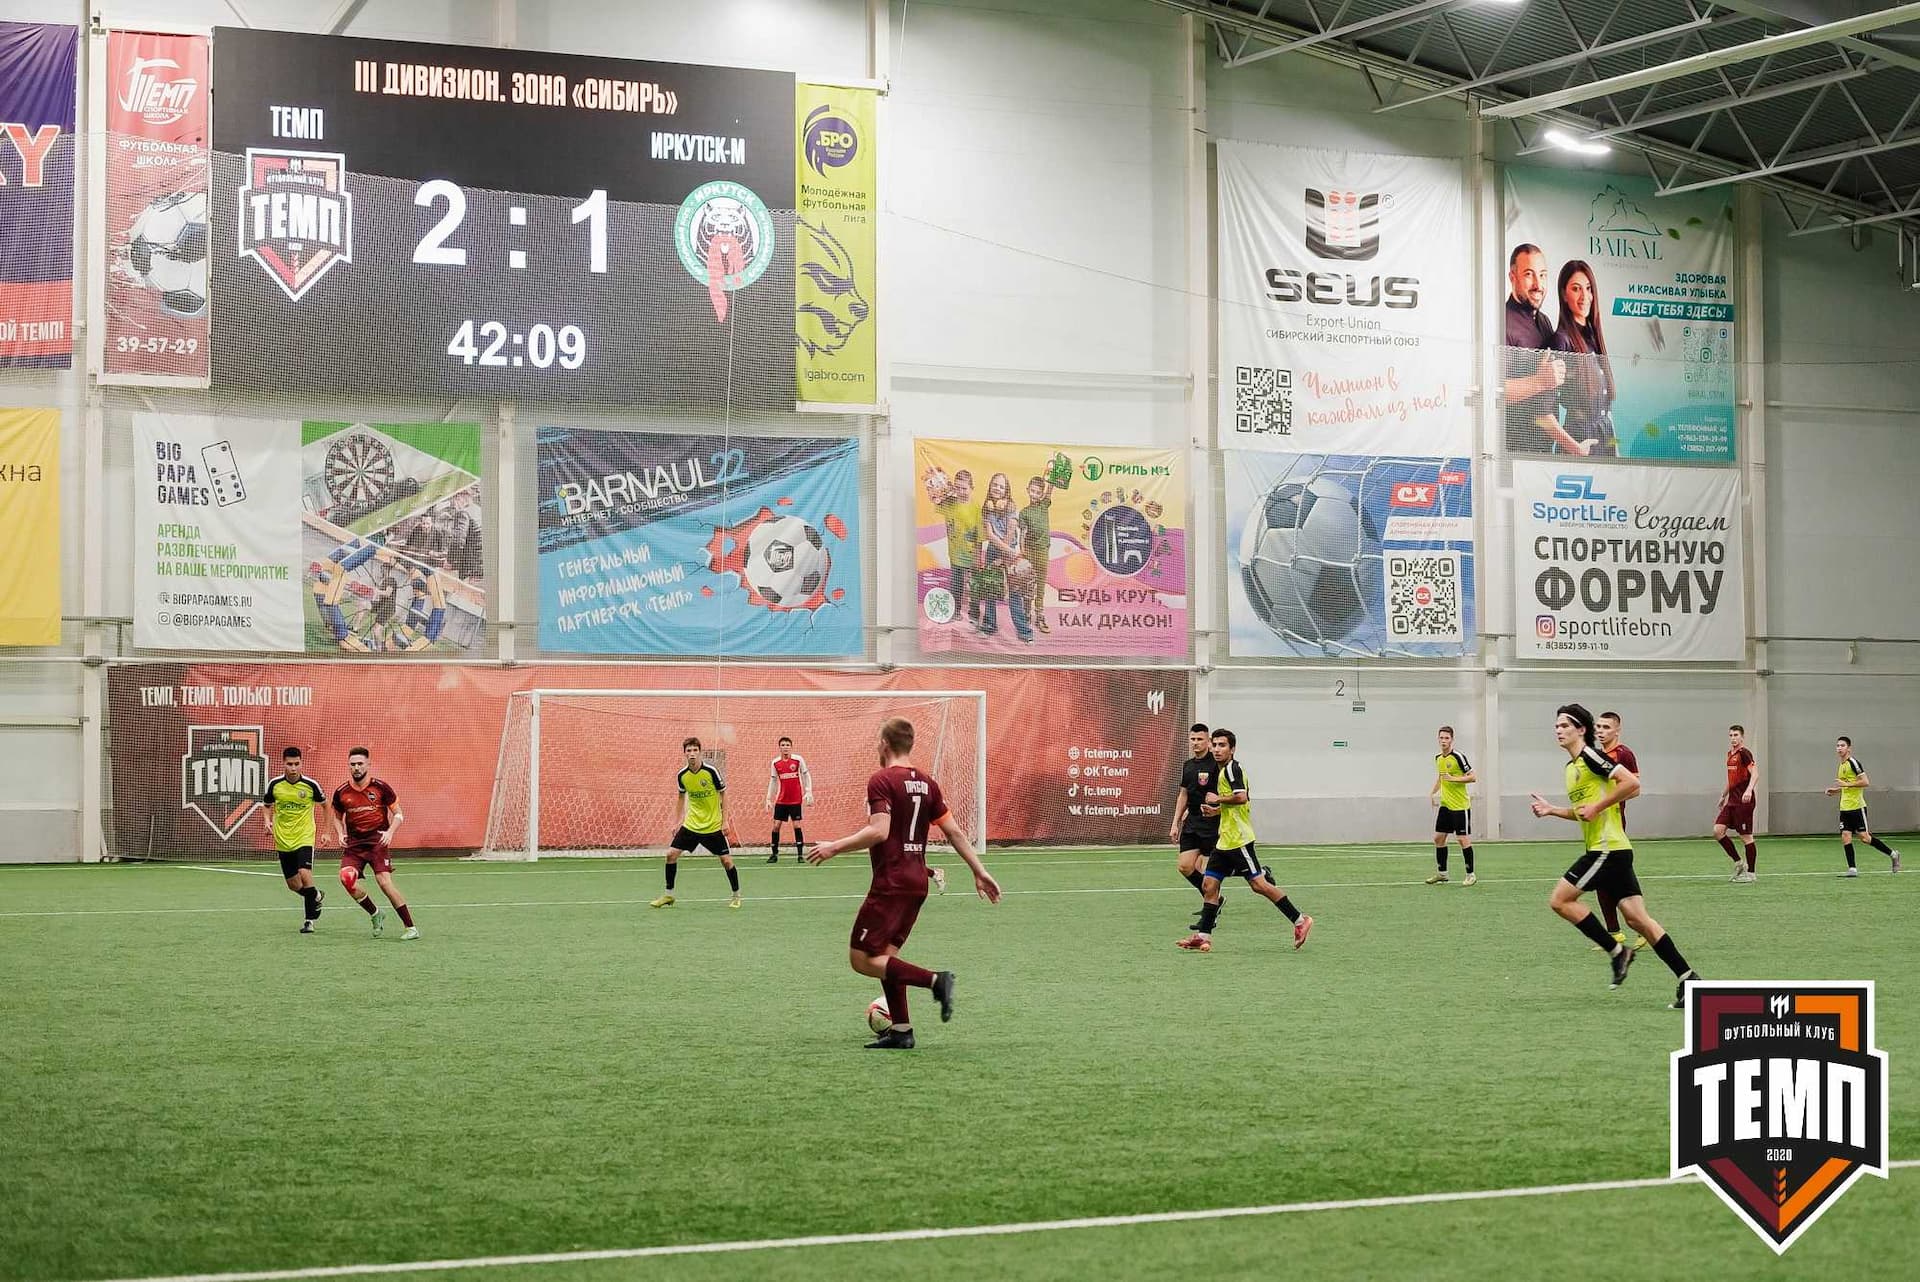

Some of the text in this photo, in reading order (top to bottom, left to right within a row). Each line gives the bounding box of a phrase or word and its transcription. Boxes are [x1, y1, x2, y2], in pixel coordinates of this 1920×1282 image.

[383, 62, 506, 102] ДИВИЗИОН.
[511, 73, 566, 107] ЗОНА
[572, 77, 678, 115] «СИБИРЬ»
[269, 105, 324, 140] ТЕМП
[119, 140, 198, 153] ФУТБОЛЬНАЯ
[650, 131, 745, 165] ИРКУТСК-М
[136, 155, 178, 166] ШКОЛА
[802, 199, 866, 211] футбольная
[250, 191, 341, 246] ТЕМП
[412, 178, 467, 266] 2
[571, 189, 608, 273] 1
[843, 214, 866, 224] лига
[1589, 236, 1663, 260] BAIKAL
[1265, 267, 1420, 309] SEUS
[1675, 272, 1727, 285] ЗДОРОВАЯ
[1628, 284, 1727, 300] И КРАСИВАЯ УЛЫБКА
[1620, 302, 1727, 319] ЖДЕТ ТЕБЯ ЗДЕСЬ!
[21, 320, 65, 342] ТЕМП!
[1306, 313, 1381, 330] Export Union
[117, 336, 198, 355] 39-57-29
[447, 319, 587, 370] 42:09
[1266, 329, 1420, 347] СИБИРСКИЙ ЭКСПОРТНЫЙ СОЮЗ
[1302, 366, 1400, 399] Чемпион в
[1308, 383, 1449, 426] каждом из нас!
[156, 441, 182, 461] BIG
[157, 463, 196, 484] PAPA
[1108, 463, 1171, 477] ГРИЛЬ №1
[157, 485, 209, 506] GAMES
[1553, 474, 1607, 500] SL
[560, 510, 612, 526] ИНТЕРНЕТ
[620, 493, 689, 515] СООБЩЕСТВО
[157, 523, 201, 540] АРЕНДА
[1634, 504, 1731, 538] Создаем
[157, 542, 237, 560] РАЗВЛЕЧЕНИЙ
[558, 542, 651, 579] ГЕНЕРАЛЬНЫЙ
[1534, 535, 1725, 565] СПОРТИВНУЮ
[157, 562, 289, 581] НА ВАШЕ МЕРОПРИЯТИЕ
[558, 562, 685, 608] ИНФОРМАЦИОННЫЙ
[1534, 566, 1724, 615] ФОРМУ
[172, 593, 253, 607] BIGPAPAGAMES.RU
[1058, 587, 1163, 608] БУДЬ КРУТ,
[172, 613, 253, 628] @BIGPAPAGAMES
[557, 605, 617, 633] ПАРТНЕР
[618, 600, 642, 619] ФК
[1058, 612, 1173, 631] КАК ДРАКОН!
[1559, 613, 1672, 640] sportlifebrn
[1577, 642, 1610, 651] 59-11-10
[140, 685, 313, 708] ТЕМП, ТЕМП, ТОЛЬКО ТЕМП!
[1335, 679, 1345, 697] 2
[1083, 747, 1133, 760] fctemp.ru
[191, 757, 260, 796] ТЕМП
[1083, 765, 1129, 777] ФК Темп
[1083, 784, 1122, 798] fc.temp
[909, 795, 922, 842] 7
[1084, 803, 1161, 817] fctemp_barnaul
[860, 928, 869, 941] 7
